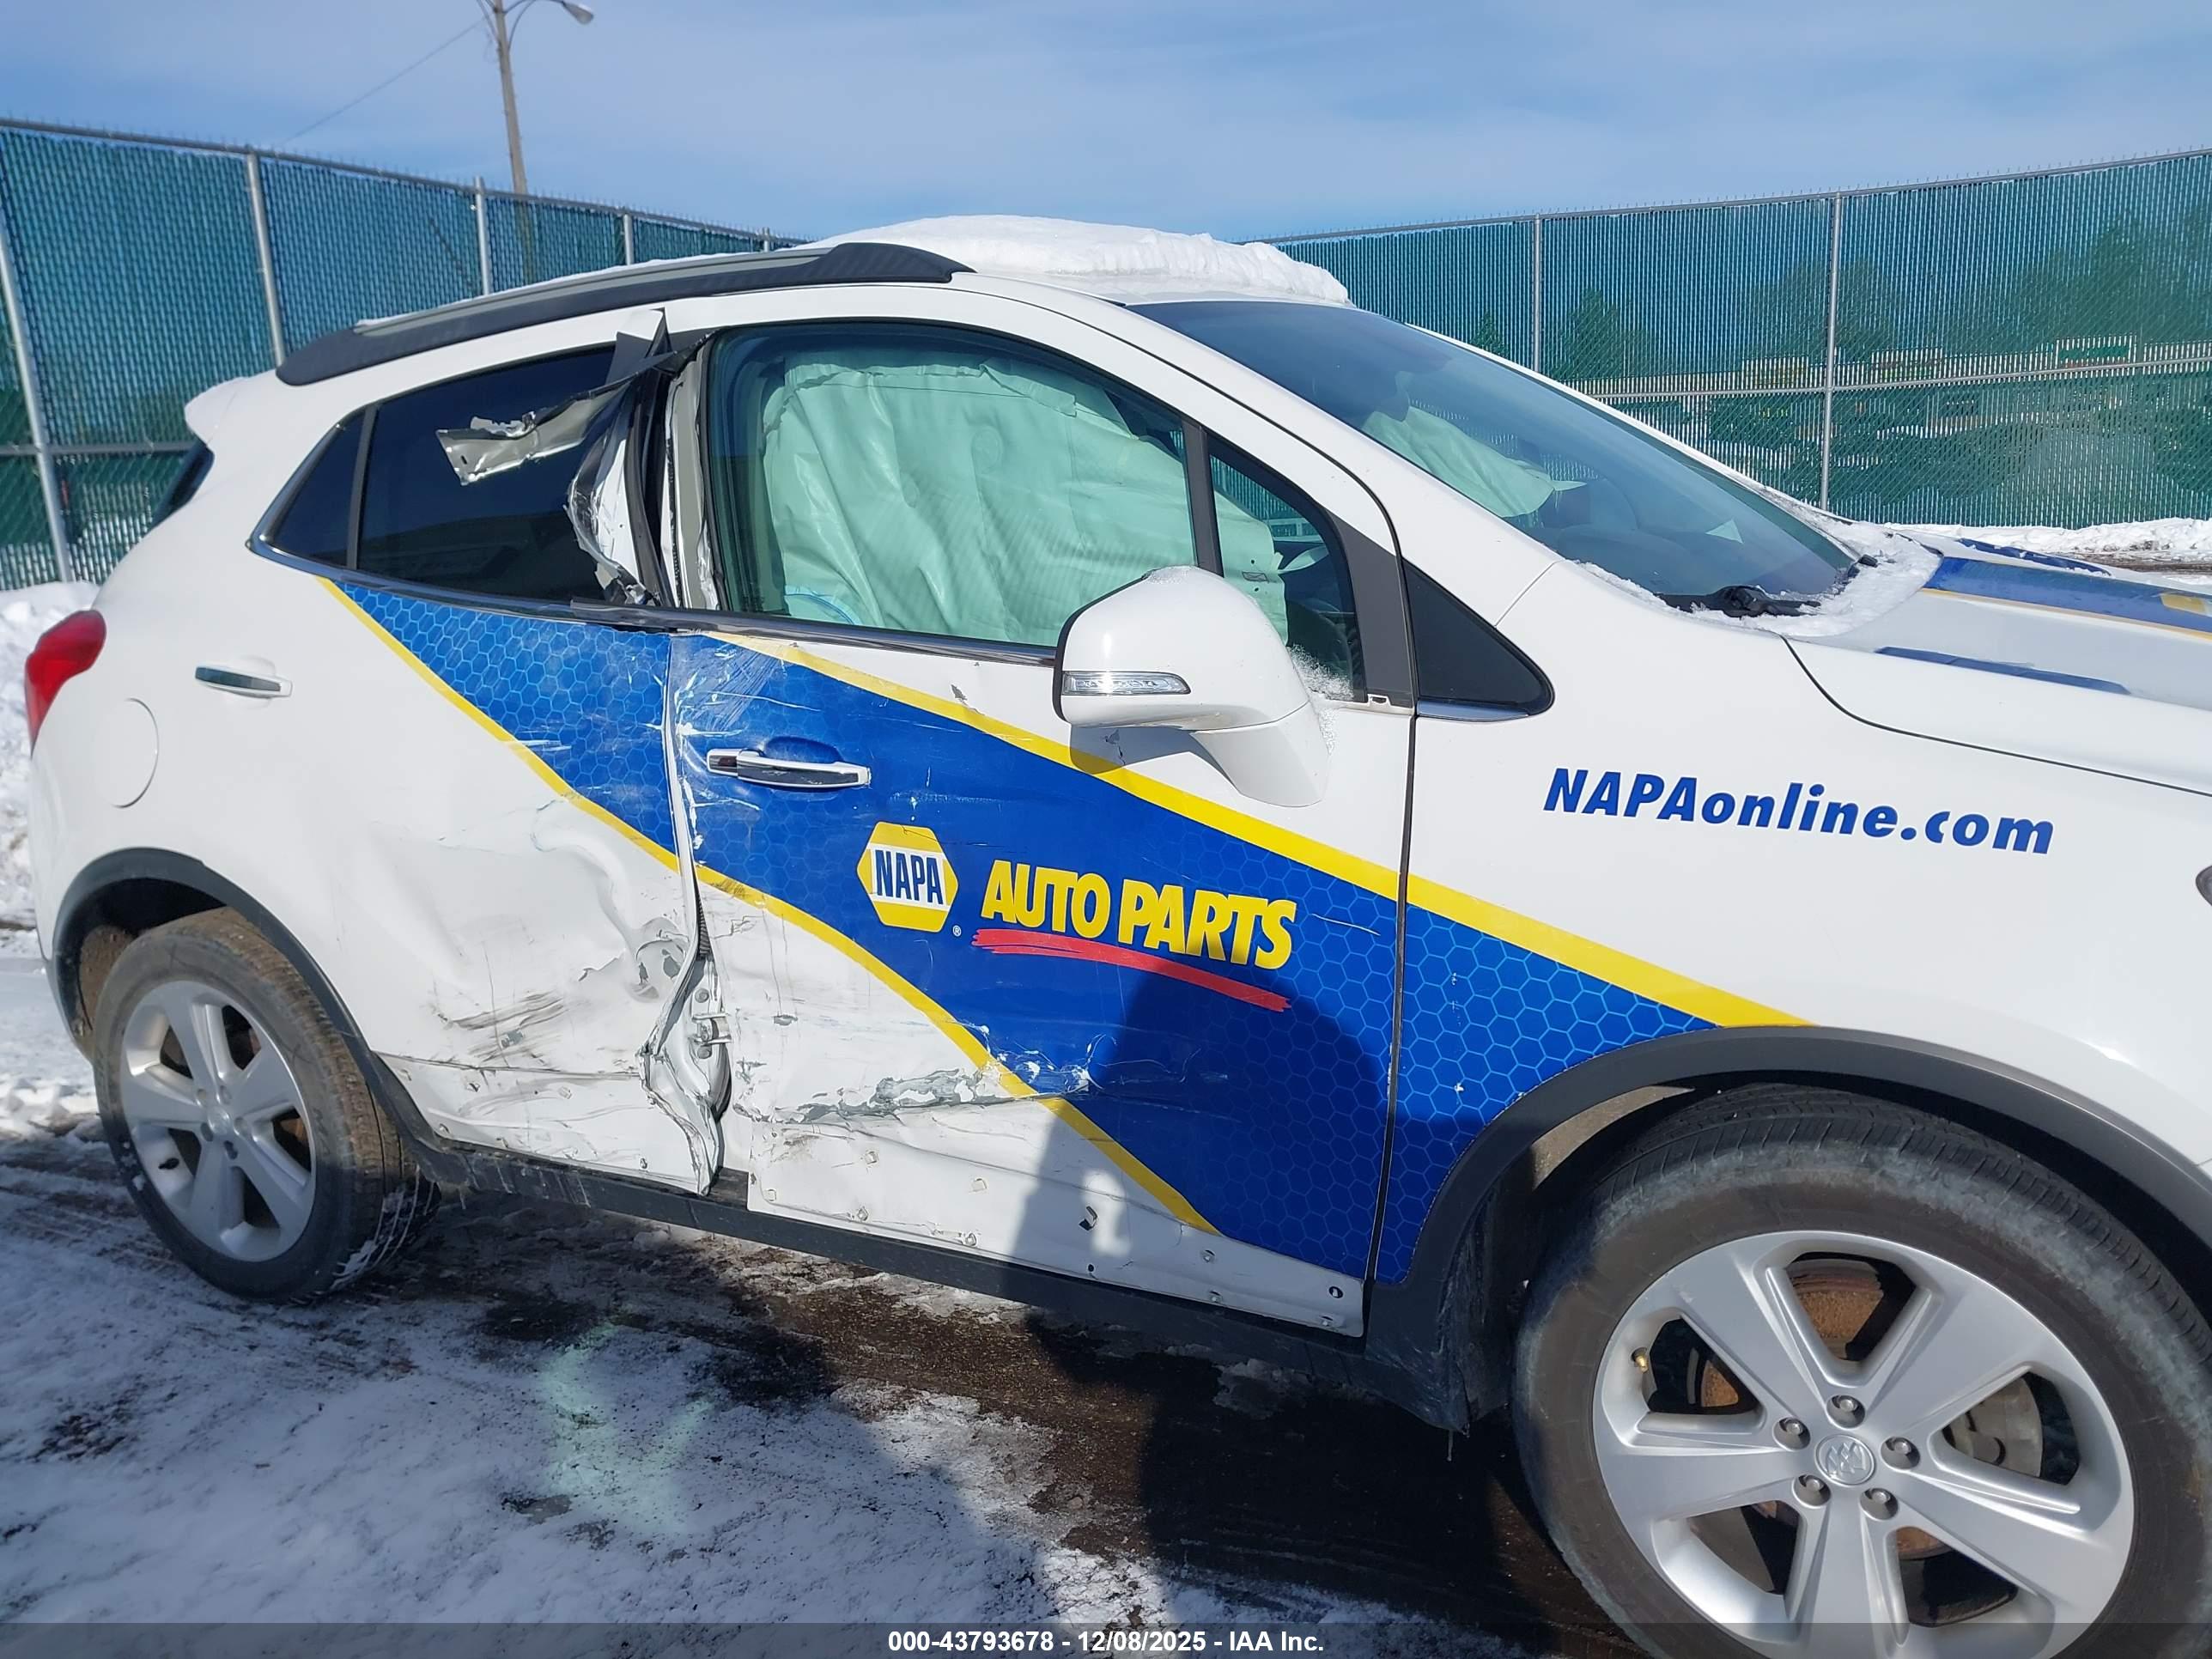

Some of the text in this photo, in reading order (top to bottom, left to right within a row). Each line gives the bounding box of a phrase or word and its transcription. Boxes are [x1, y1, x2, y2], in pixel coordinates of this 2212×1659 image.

[1543, 768, 2054, 854] NAPAonline.com
[874, 848, 945, 906] NAPA
[981, 860, 1297, 969] AUTO PARTS
